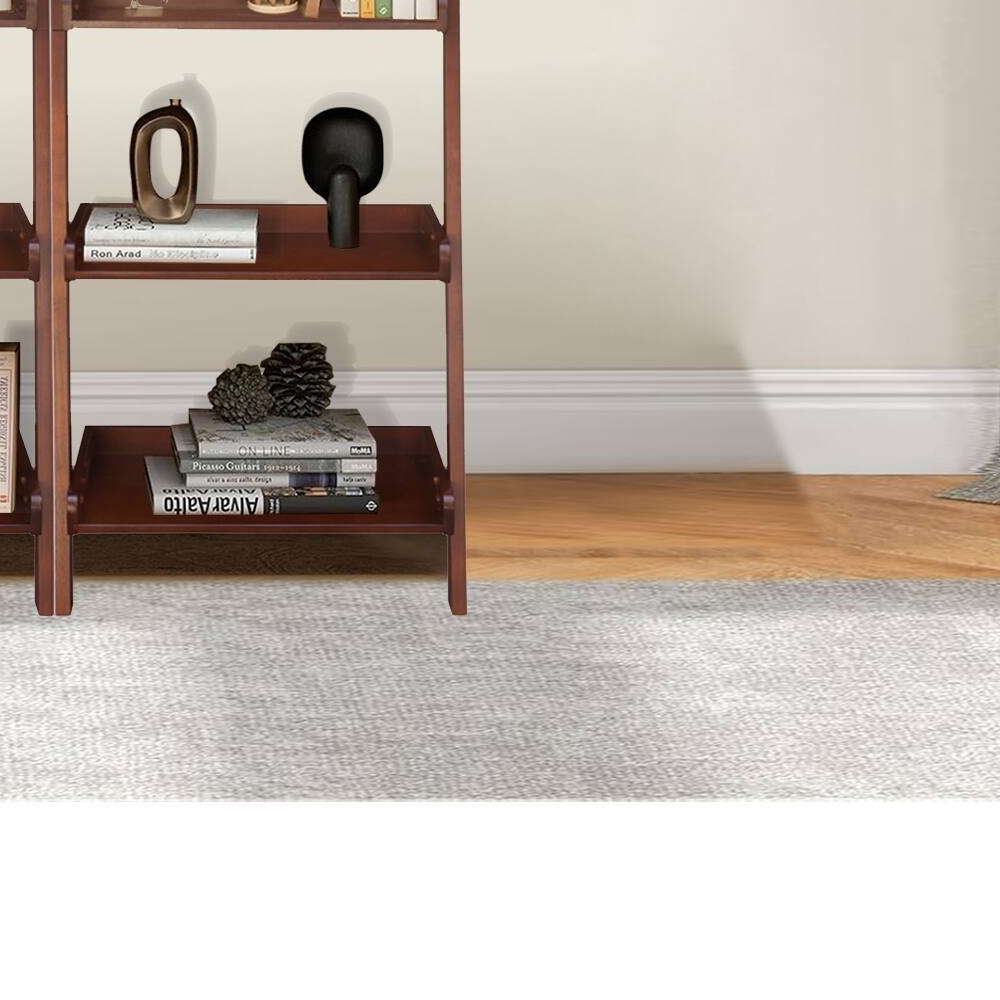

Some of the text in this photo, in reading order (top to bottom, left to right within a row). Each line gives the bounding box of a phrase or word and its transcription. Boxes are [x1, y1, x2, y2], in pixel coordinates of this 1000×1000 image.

[90, 250, 142, 258] Ron Arad
[238, 446, 256, 457] ON
[263, 446, 290, 457] LINE
[192, 462, 224, 471] Picasso
[226, 462, 260, 471] Guitars
